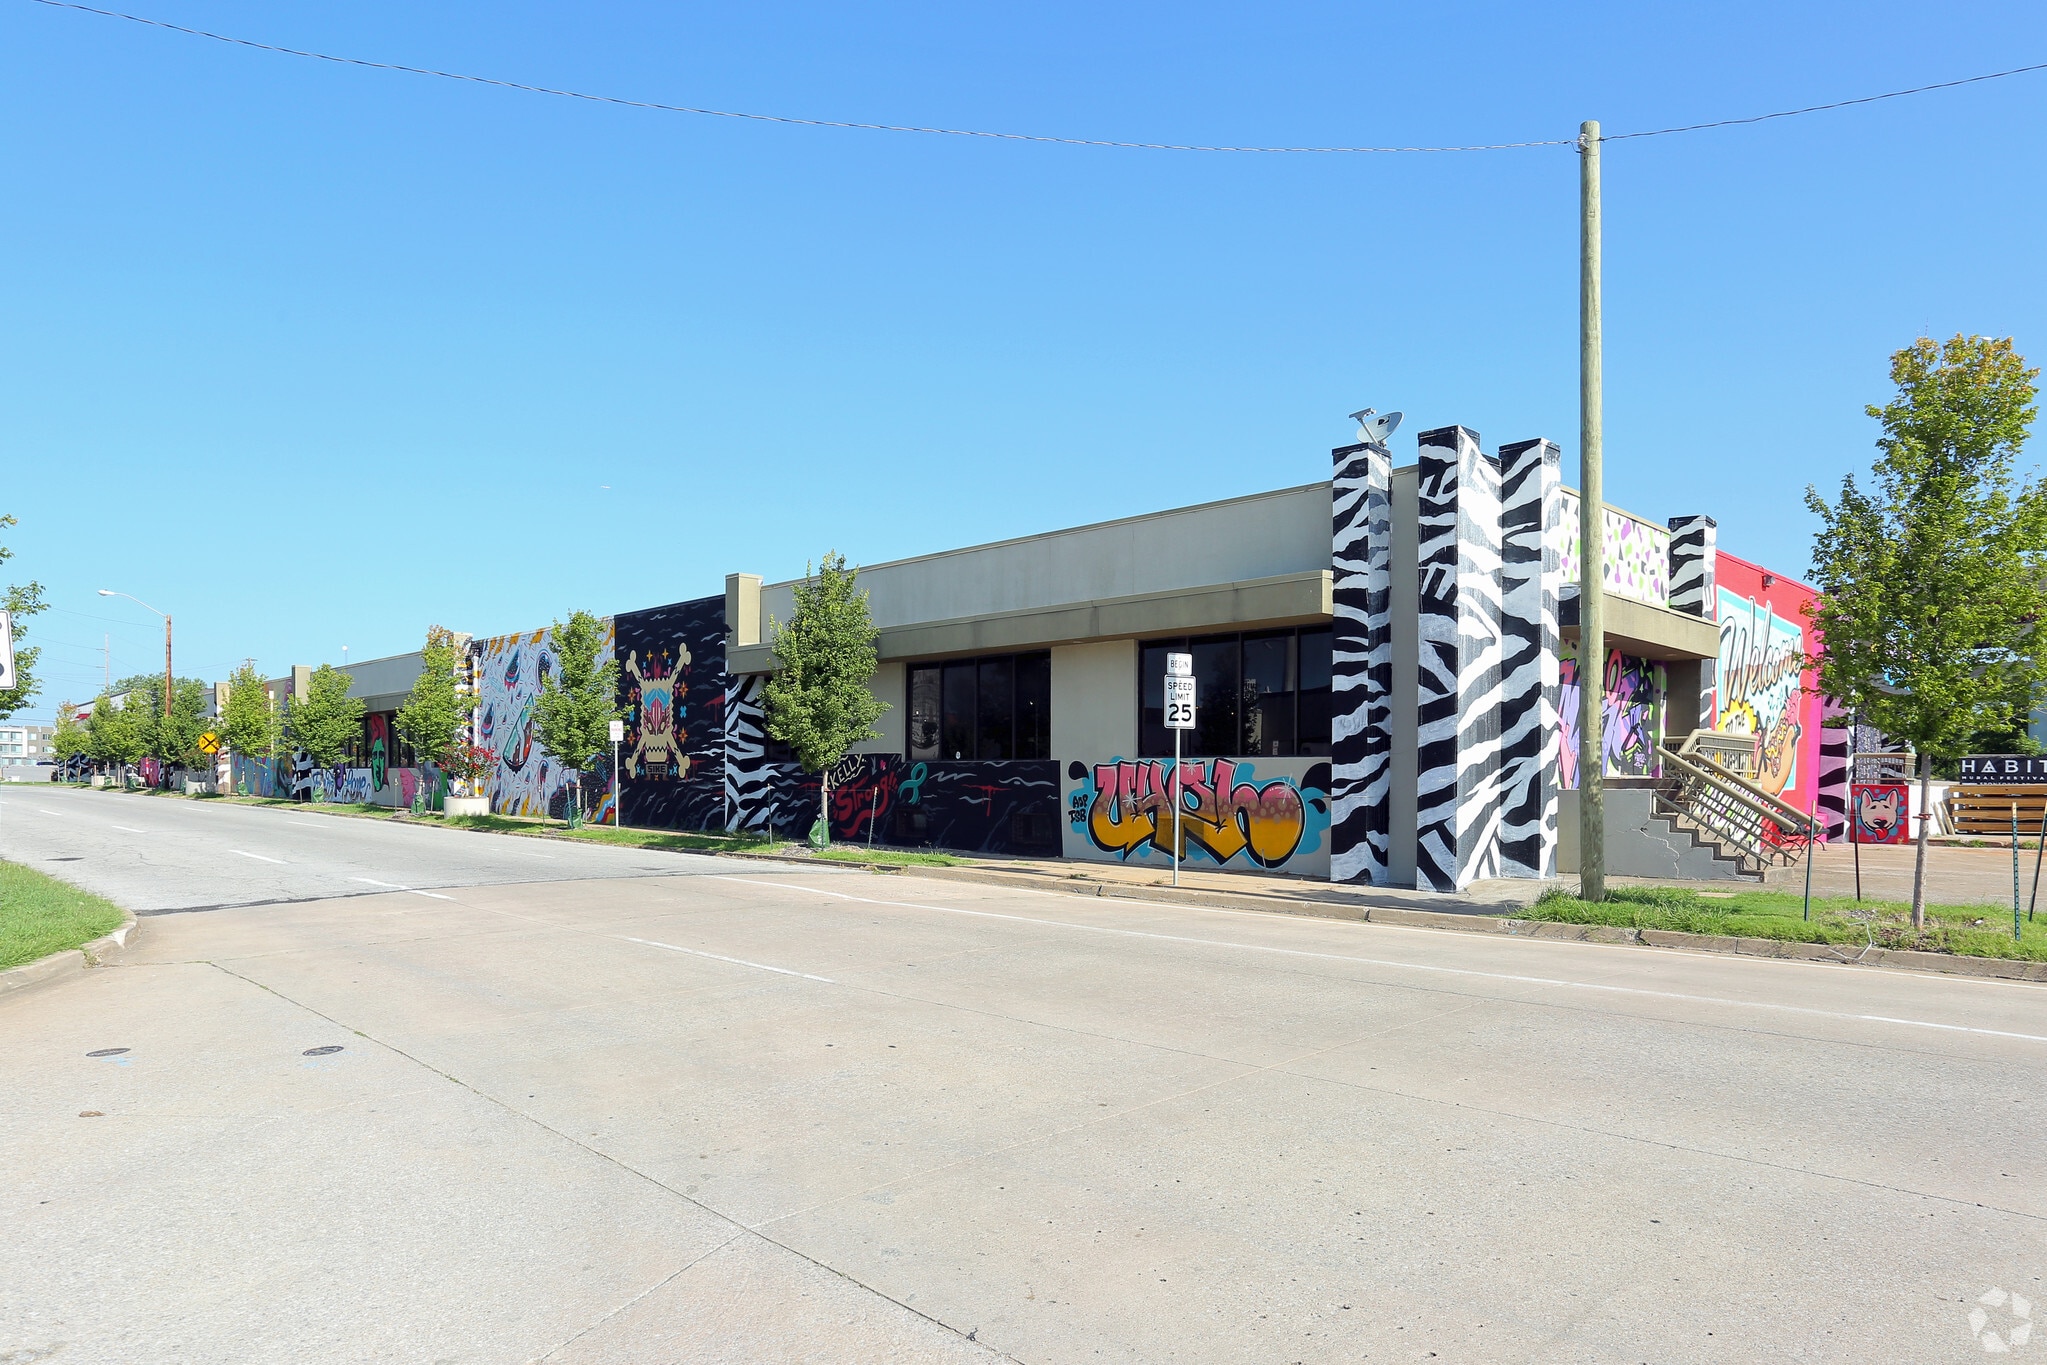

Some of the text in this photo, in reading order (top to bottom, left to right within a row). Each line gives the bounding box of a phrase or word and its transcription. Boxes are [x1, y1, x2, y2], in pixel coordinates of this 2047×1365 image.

[1718, 597, 1803, 711] Welcome
[1170, 659, 1189, 669] BEGIN
[1167, 681, 1193, 691] SPEED
[1170, 692, 1190, 701] LIMIT
[1168, 703, 1192, 722] 25
[829, 753, 863, 790] KELLY
[1961, 759, 2047, 773] HABIT
